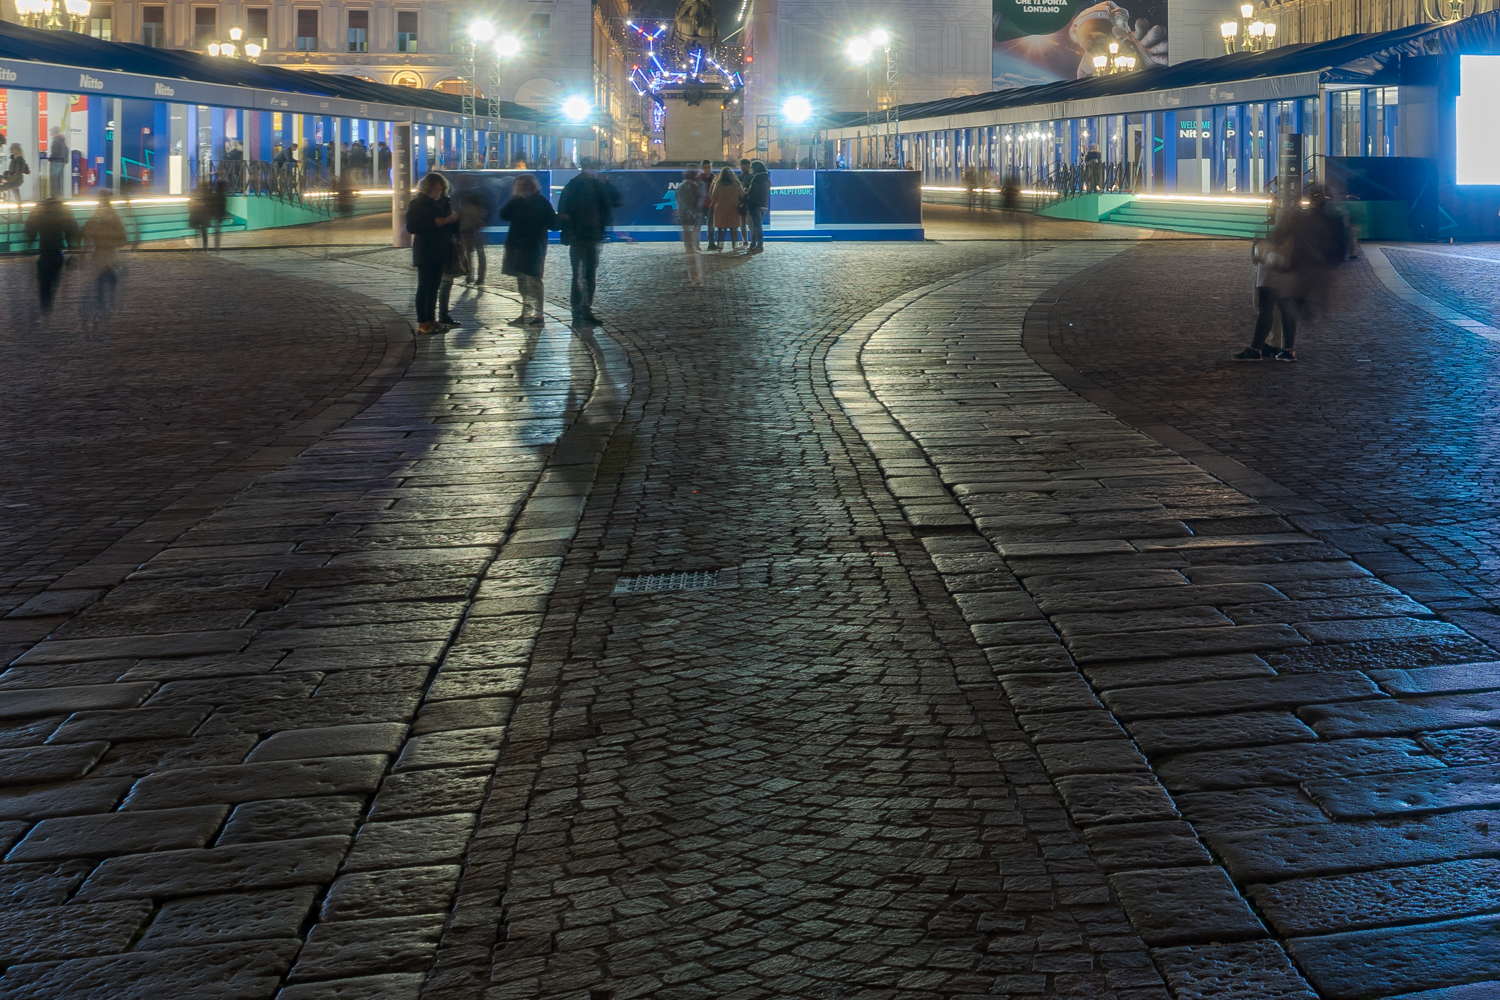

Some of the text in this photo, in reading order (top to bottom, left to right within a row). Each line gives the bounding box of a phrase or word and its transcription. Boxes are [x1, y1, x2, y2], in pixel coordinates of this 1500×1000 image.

[1023, 5, 1060, 14] LONTANO
[0, 68, 17, 82] itto
[79, 74, 104, 90] Nitto
[154, 82, 175, 97] Nitto
[1179, 129, 1210, 138] Nito
